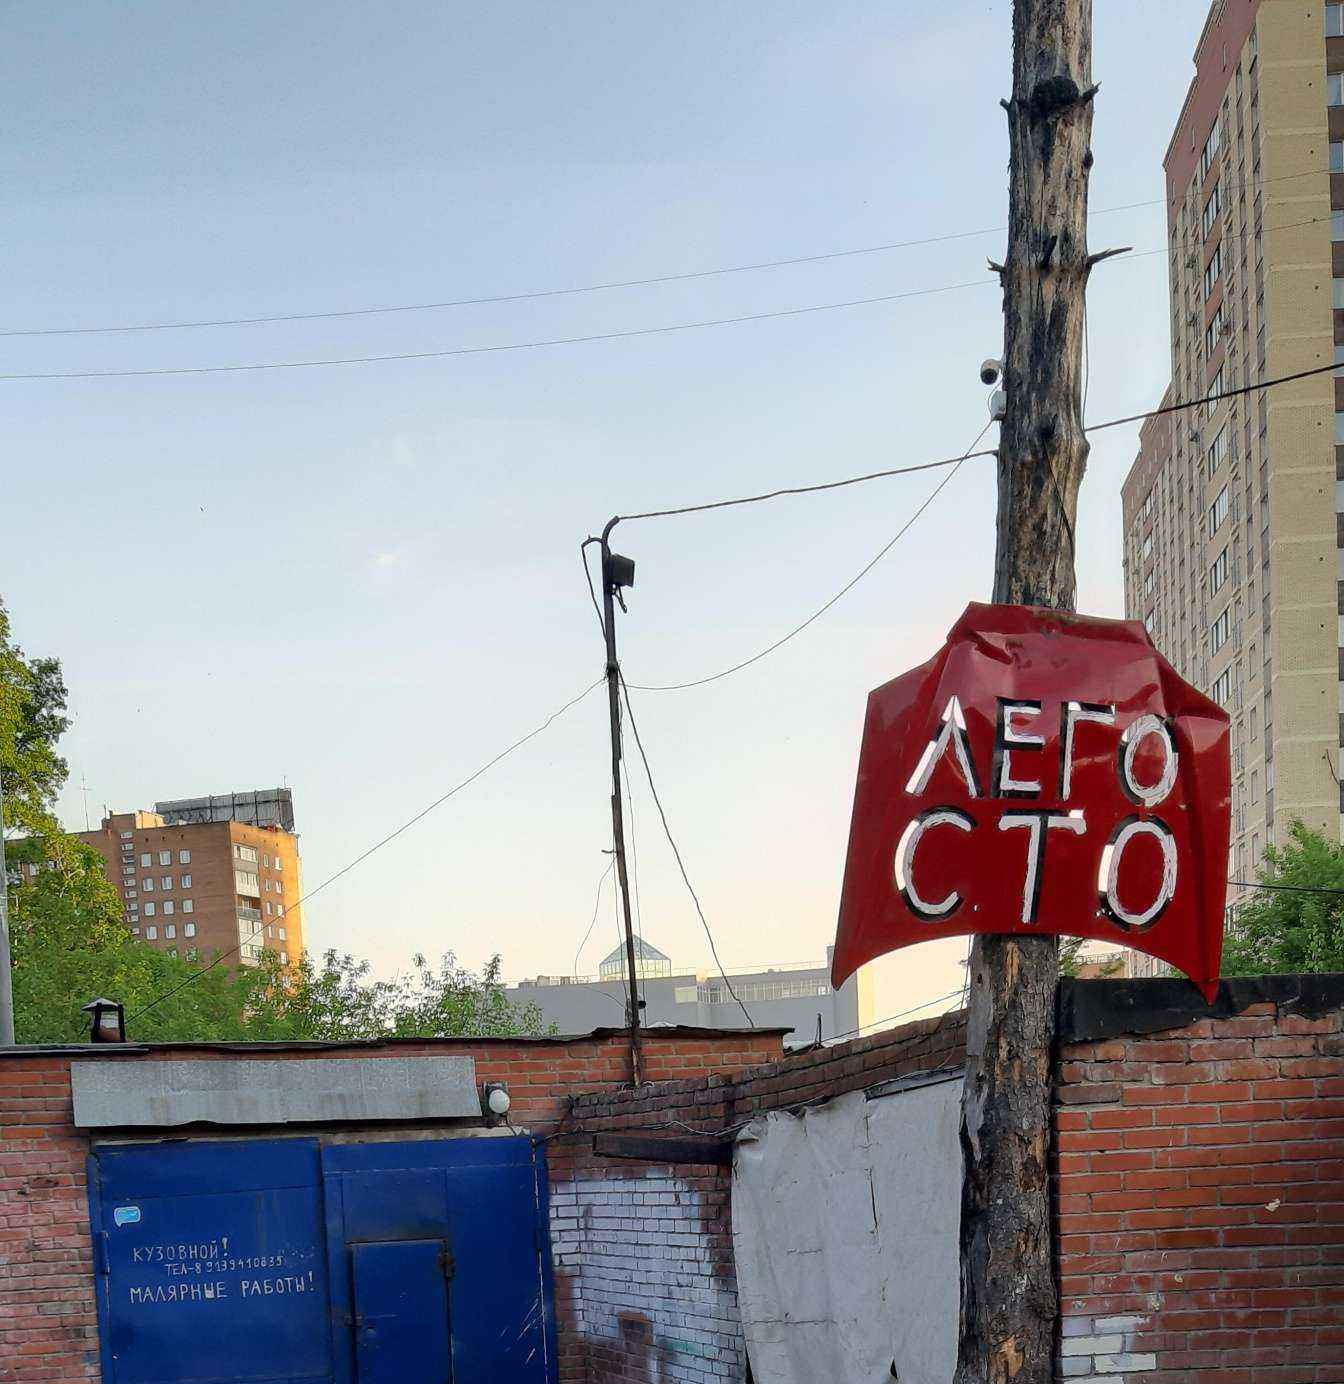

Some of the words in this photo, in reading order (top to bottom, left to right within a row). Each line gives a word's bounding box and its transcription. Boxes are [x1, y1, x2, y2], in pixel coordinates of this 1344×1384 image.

[905, 695, 1180, 808] ЛЕГО
[894, 805, 1178, 932] СТО
[133, 1237, 230, 1262] КУЗОВНОЙ!
[241, 1271, 316, 1298] РАБОТЫ!
